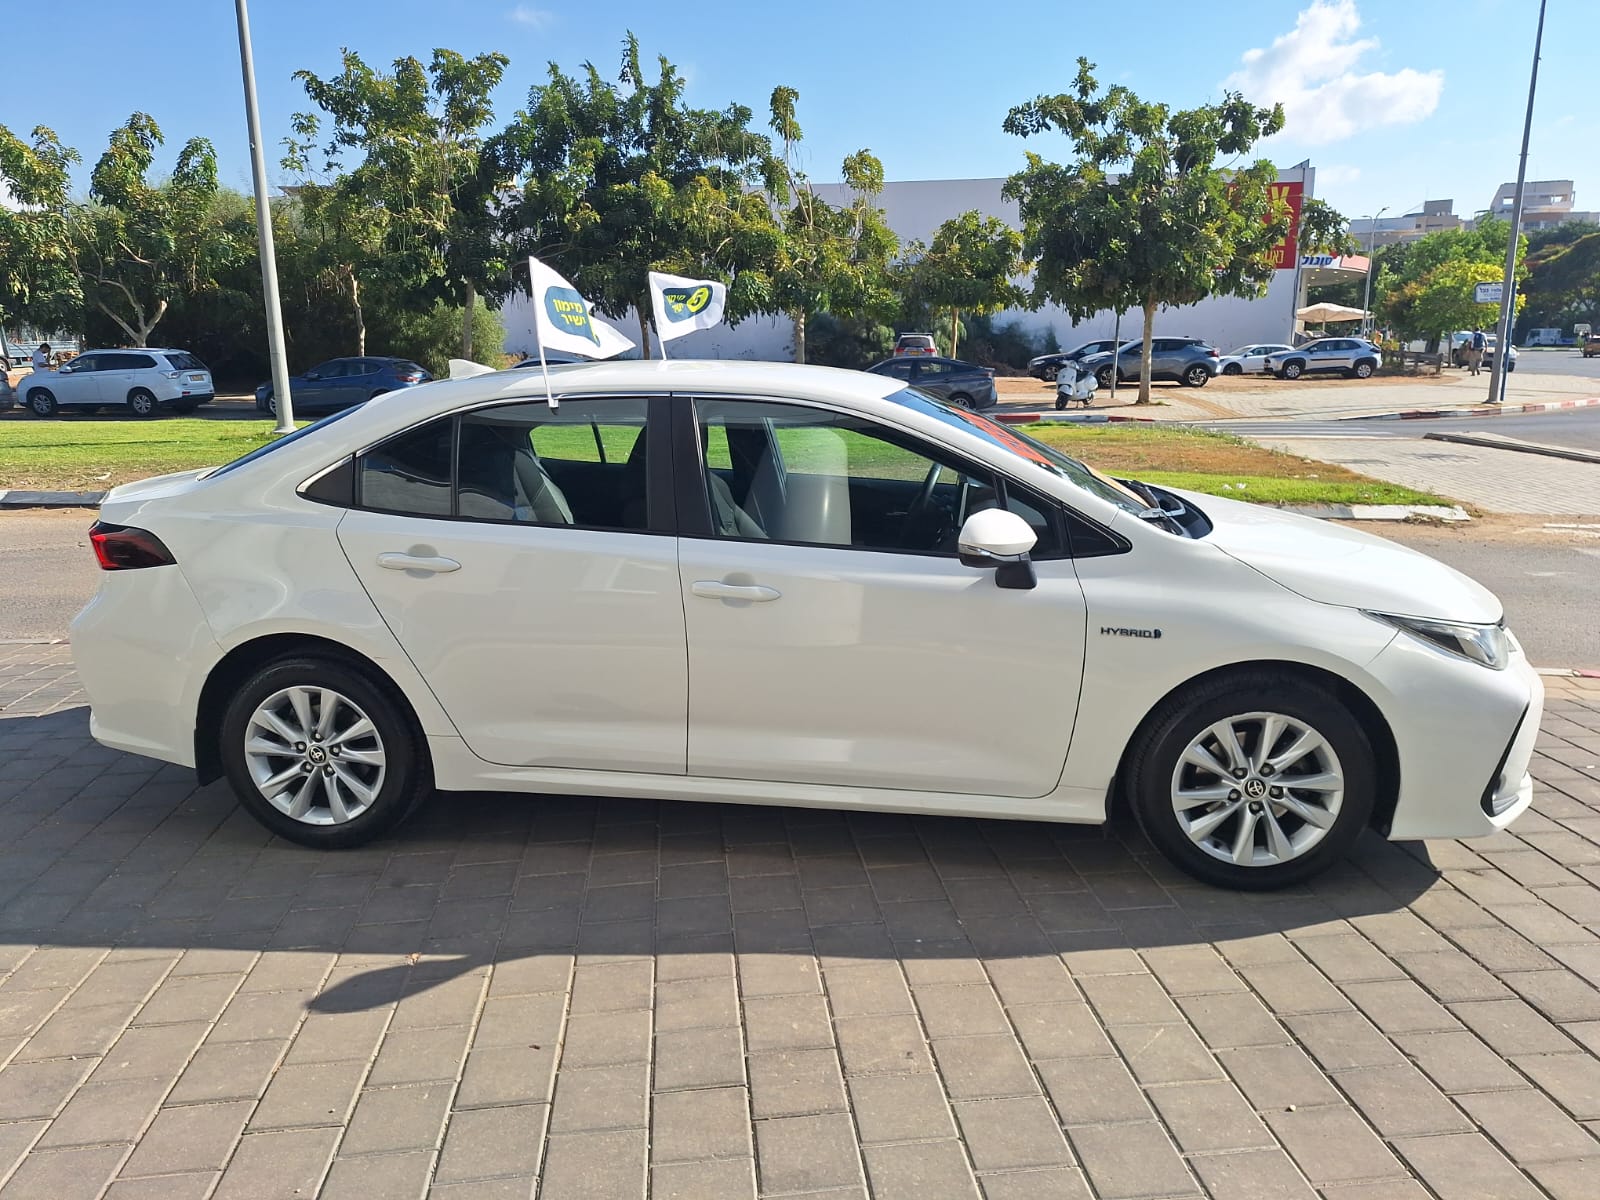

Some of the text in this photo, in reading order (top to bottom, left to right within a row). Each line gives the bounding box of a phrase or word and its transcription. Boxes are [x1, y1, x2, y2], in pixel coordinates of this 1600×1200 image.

[552, 298, 583, 314] מימון
[560, 313, 586, 326] ישיר
[1101, 627, 1153, 638] HYBRID
